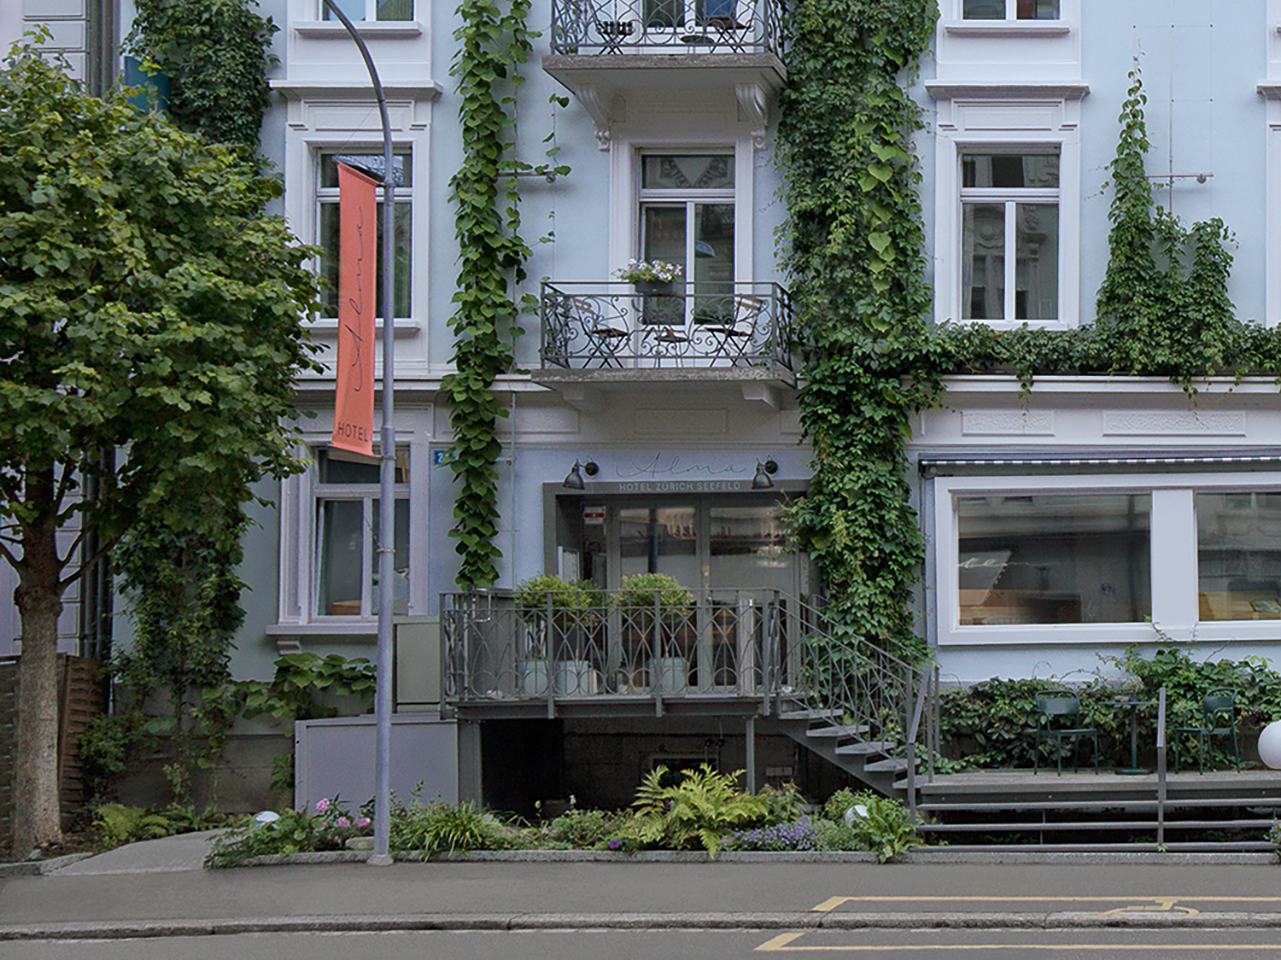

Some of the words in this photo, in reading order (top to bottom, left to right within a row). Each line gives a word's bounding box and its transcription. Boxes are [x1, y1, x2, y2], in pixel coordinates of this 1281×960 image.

[344, 205, 364, 392] Alma
[337, 421, 369, 443] HOTEL
[615, 451, 748, 478] Alma
[618, 482, 651, 492] HOTEL
[655, 481, 694, 492] ZÜRICH
[696, 481, 741, 491] SEEFELD
